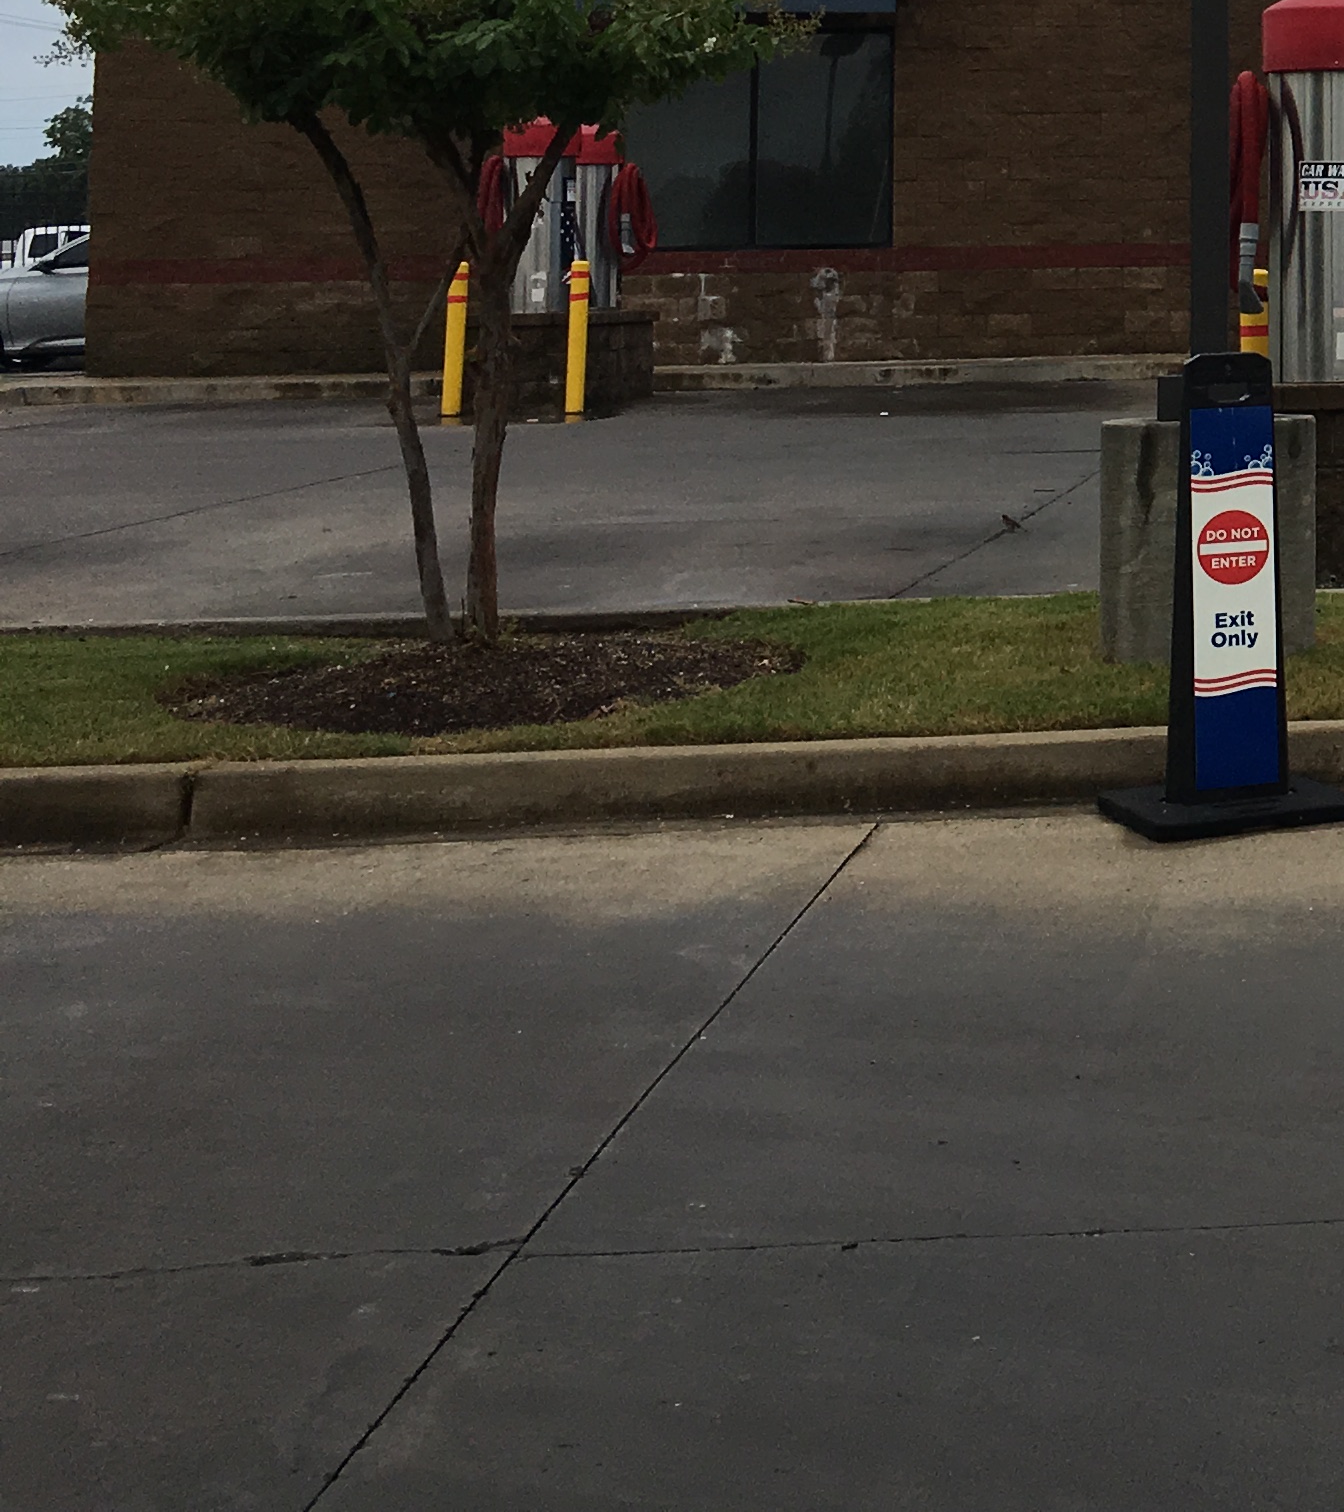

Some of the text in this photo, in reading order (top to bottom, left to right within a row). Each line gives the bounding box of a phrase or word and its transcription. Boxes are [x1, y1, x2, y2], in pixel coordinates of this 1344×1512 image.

[1301, 164, 1324, 177] CAR
[1206, 527, 1260, 541] DO NOT
[1211, 555, 1256, 569] ENTER
[1215, 610, 1254, 628] Exit
[1211, 630, 1258, 648] Only
